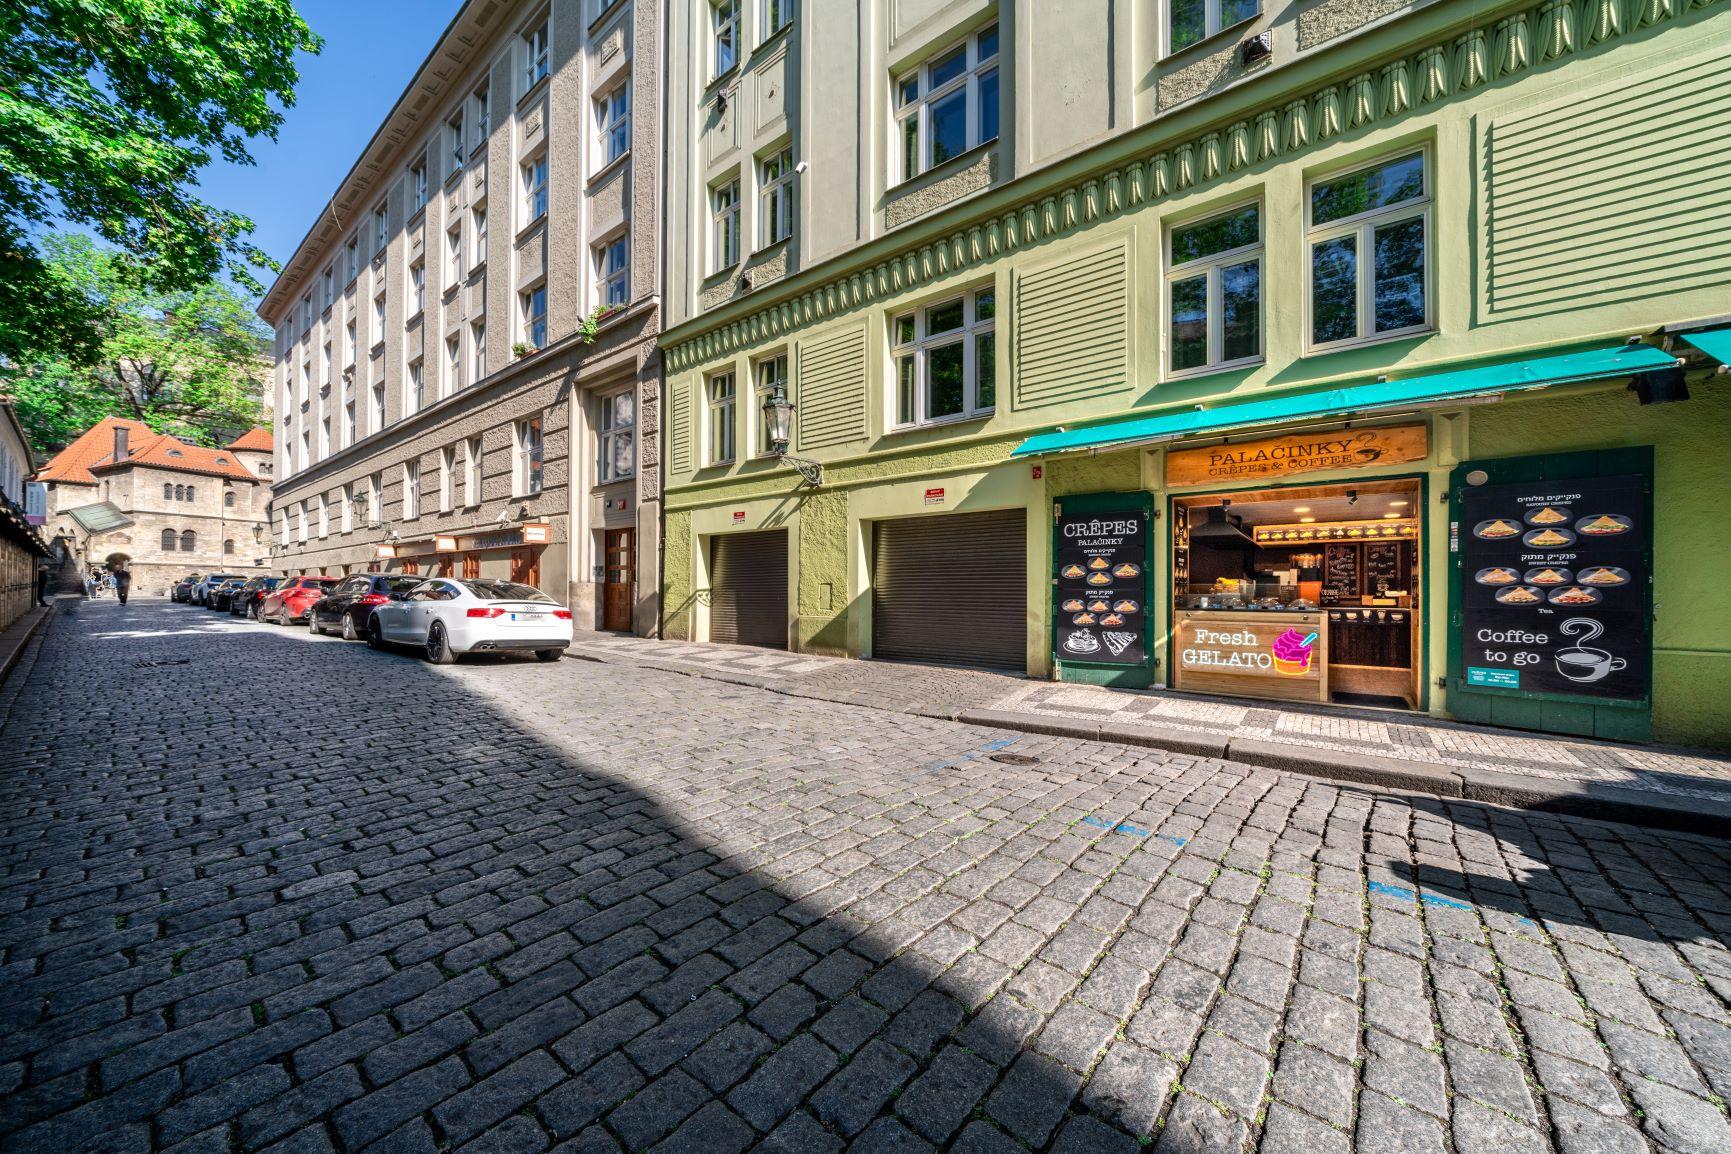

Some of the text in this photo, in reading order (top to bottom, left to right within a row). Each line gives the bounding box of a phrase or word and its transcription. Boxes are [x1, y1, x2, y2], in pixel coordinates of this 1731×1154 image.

[1209, 440, 1354, 466] PALAČINKY
[1208, 454, 1352, 476] CRÊPES & COFFEE
[1064, 519, 1138, 537] CRÊPES
[1078, 538, 1123, 546] PALAČINKY
[1194, 627, 1259, 646] Fresh
[1477, 628, 1548, 644] Coffee
[1182, 648, 1272, 668] GELATO
[1484, 649, 1540, 666] to go
